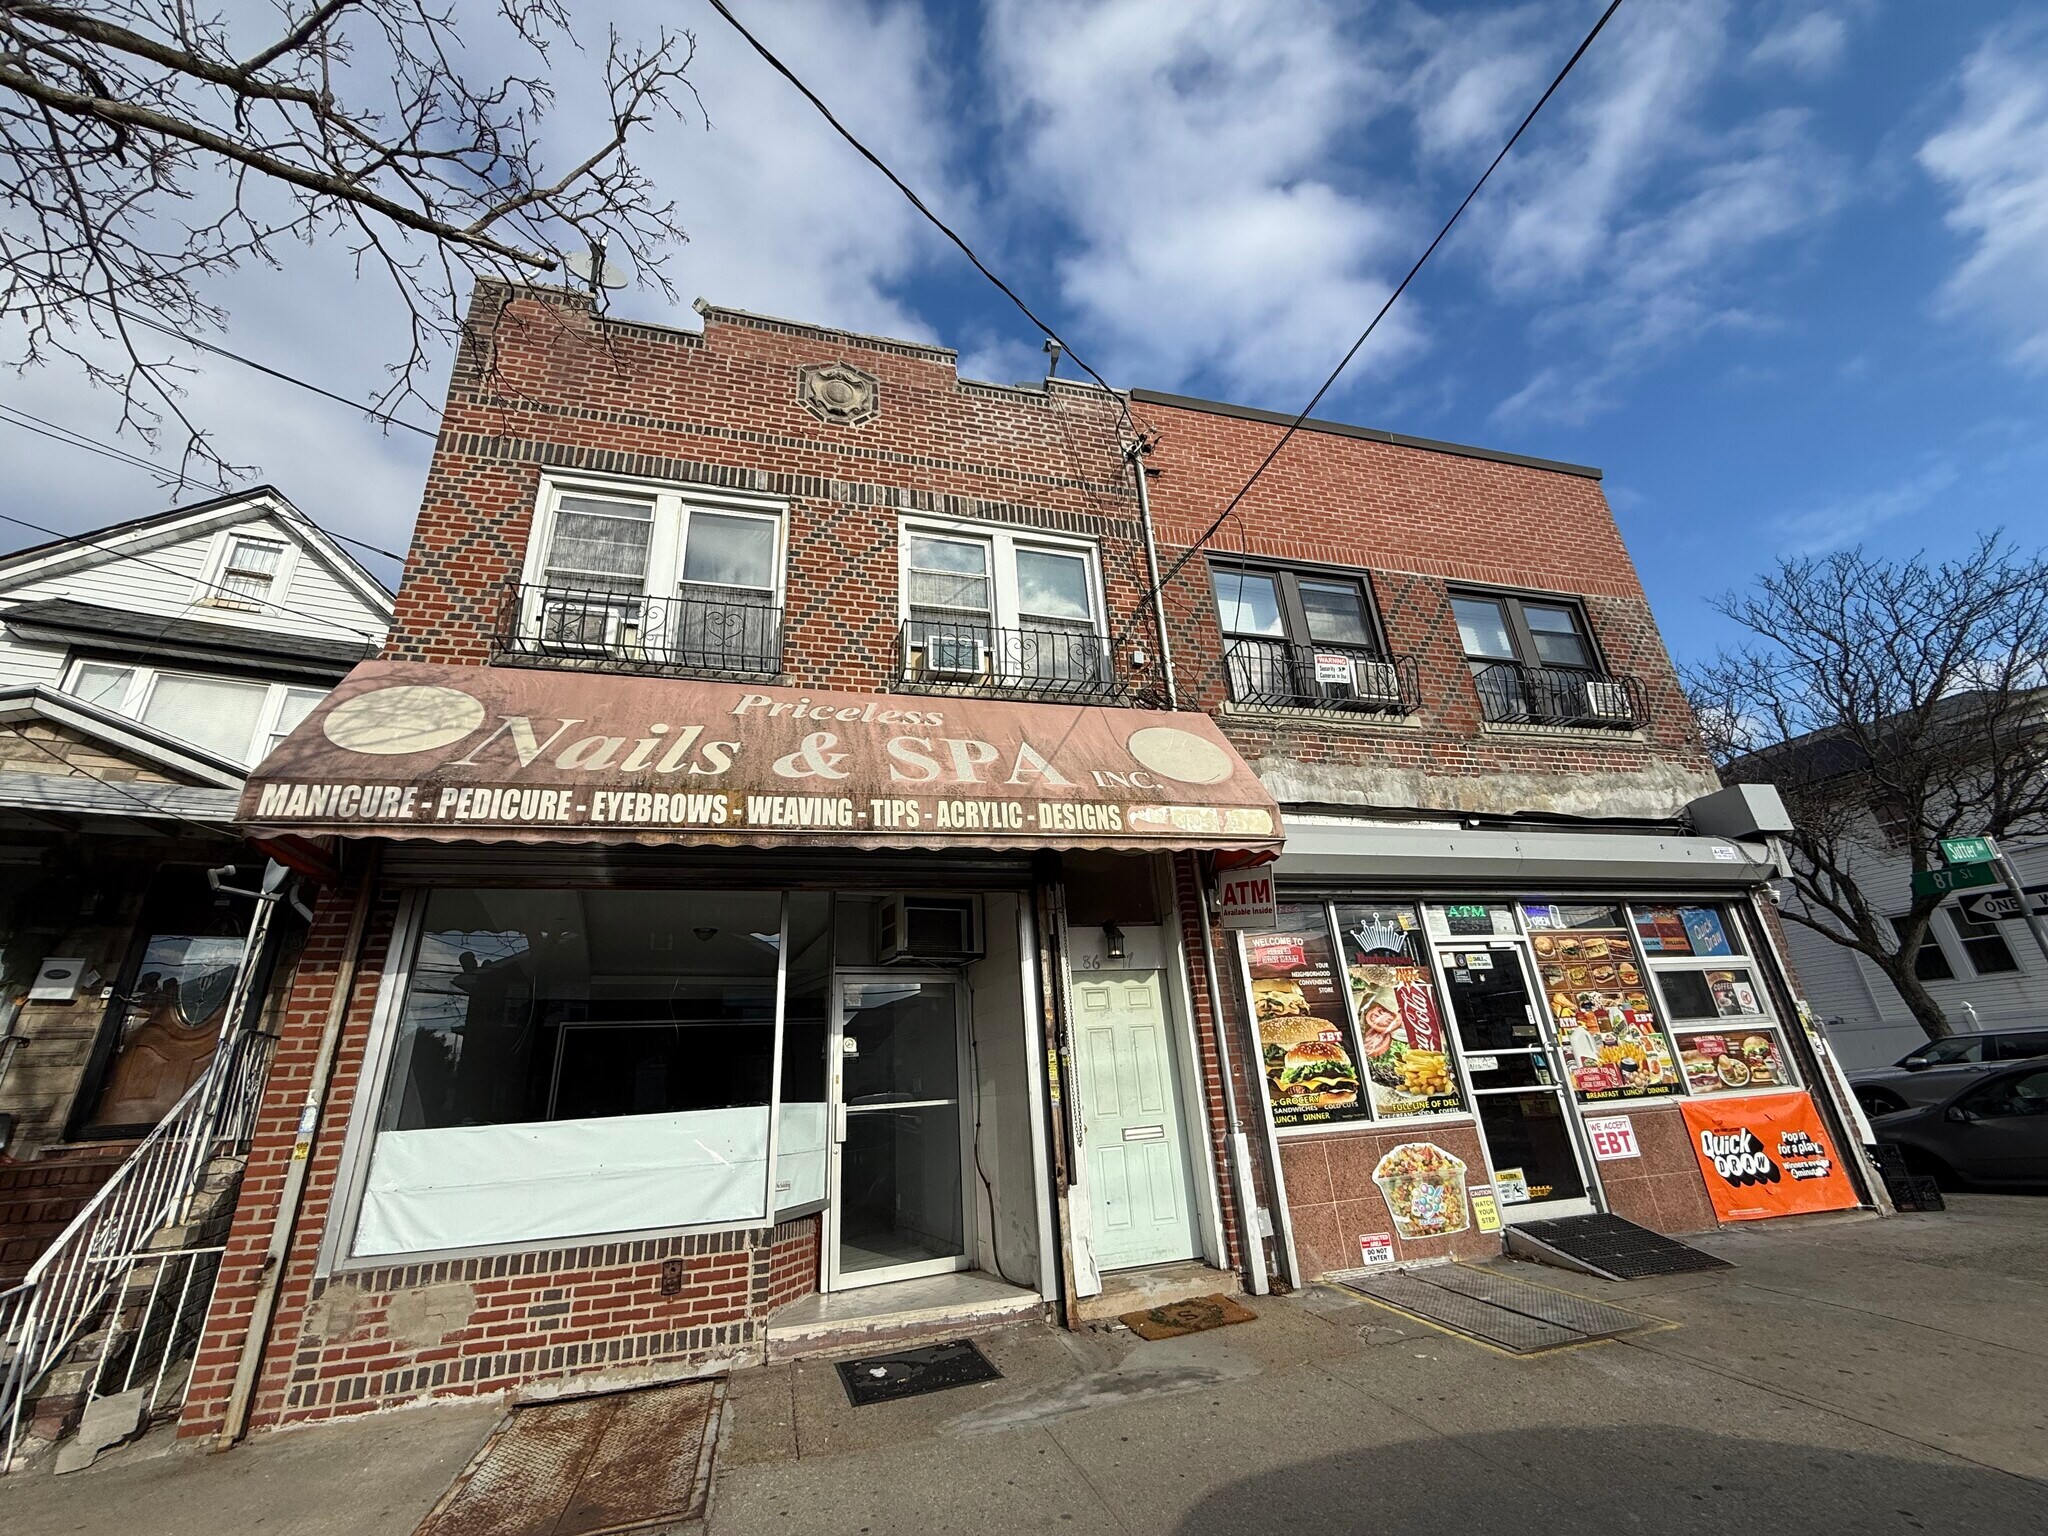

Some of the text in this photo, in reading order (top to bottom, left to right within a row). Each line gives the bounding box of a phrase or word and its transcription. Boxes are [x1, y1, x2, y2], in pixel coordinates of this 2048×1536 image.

[1318, 657, 1346, 665] WARNING
[729, 694, 945, 728] Priceless
[447, 714, 1165, 790] Nails & SPA INC.
[256, 784, 415, 819] MANICURE
[440, 787, 572, 822] PEDICURE
[597, 793, 728, 825] EYEBROWS
[747, 796, 854, 828] WEAVING
[871, 799, 920, 829] TIPS
[936, 801, 1024, 830] ACRYLIC
[1038, 803, 1123, 832] DESIGNS
[1946, 842, 1978, 860] Sutter
[1932, 868, 1975, 889] 87 St
[1223, 879, 1271, 906] ATM
[1223, 908, 1251, 917] Available
[1252, 906, 1273, 915] Inside
[1447, 905, 1487, 918] ATM
[1985, 898, 2020, 913] ONE
[1531, 916, 1551, 926] OPEN
[1693, 917, 1714, 941] Quick
[1252, 937, 1304, 947] WELCOME TO
[1704, 930, 1724, 953] Draw
[1082, 953, 1101, 970] 86
[1298, 978, 1333, 986] CONVENIENCE
[1559, 1017, 1578, 1028] ATM
[1633, 1013, 1654, 1023] EBT
[1318, 1030, 1343, 1042] EBT
[1573, 1067, 1600, 1076] WELCOME
[1586, 1090, 1619, 1099] BREAKFAST
[1647, 1086, 1670, 1095] DINNER
[1279, 1095, 1320, 1106] GROCERY
[1392, 1098, 1460, 1111] FULL LINE OF DELI
[1273, 1105, 1318, 1114] SANDWICHES
[1342, 1101, 1359, 1109] CUTS
[1303, 1112, 1331, 1121] DINNER
[1590, 1120, 1628, 1131] WE ACCEPT
[1593, 1130, 1632, 1155] EBT
[1781, 1129, 1808, 1143] Pop in
[1777, 1142, 1791, 1155] for
[1791, 1144, 1799, 1153] a
[1717, 1154, 1768, 1175] DRAW
[1782, 1160, 1809, 1170] Winners
[1470, 1189, 1492, 1197] CAUTION
[1475, 1200, 1494, 1208] WATCH
[1367, 1248, 1376, 1256] DO
[1370, 1254, 1388, 1262] ENTER
